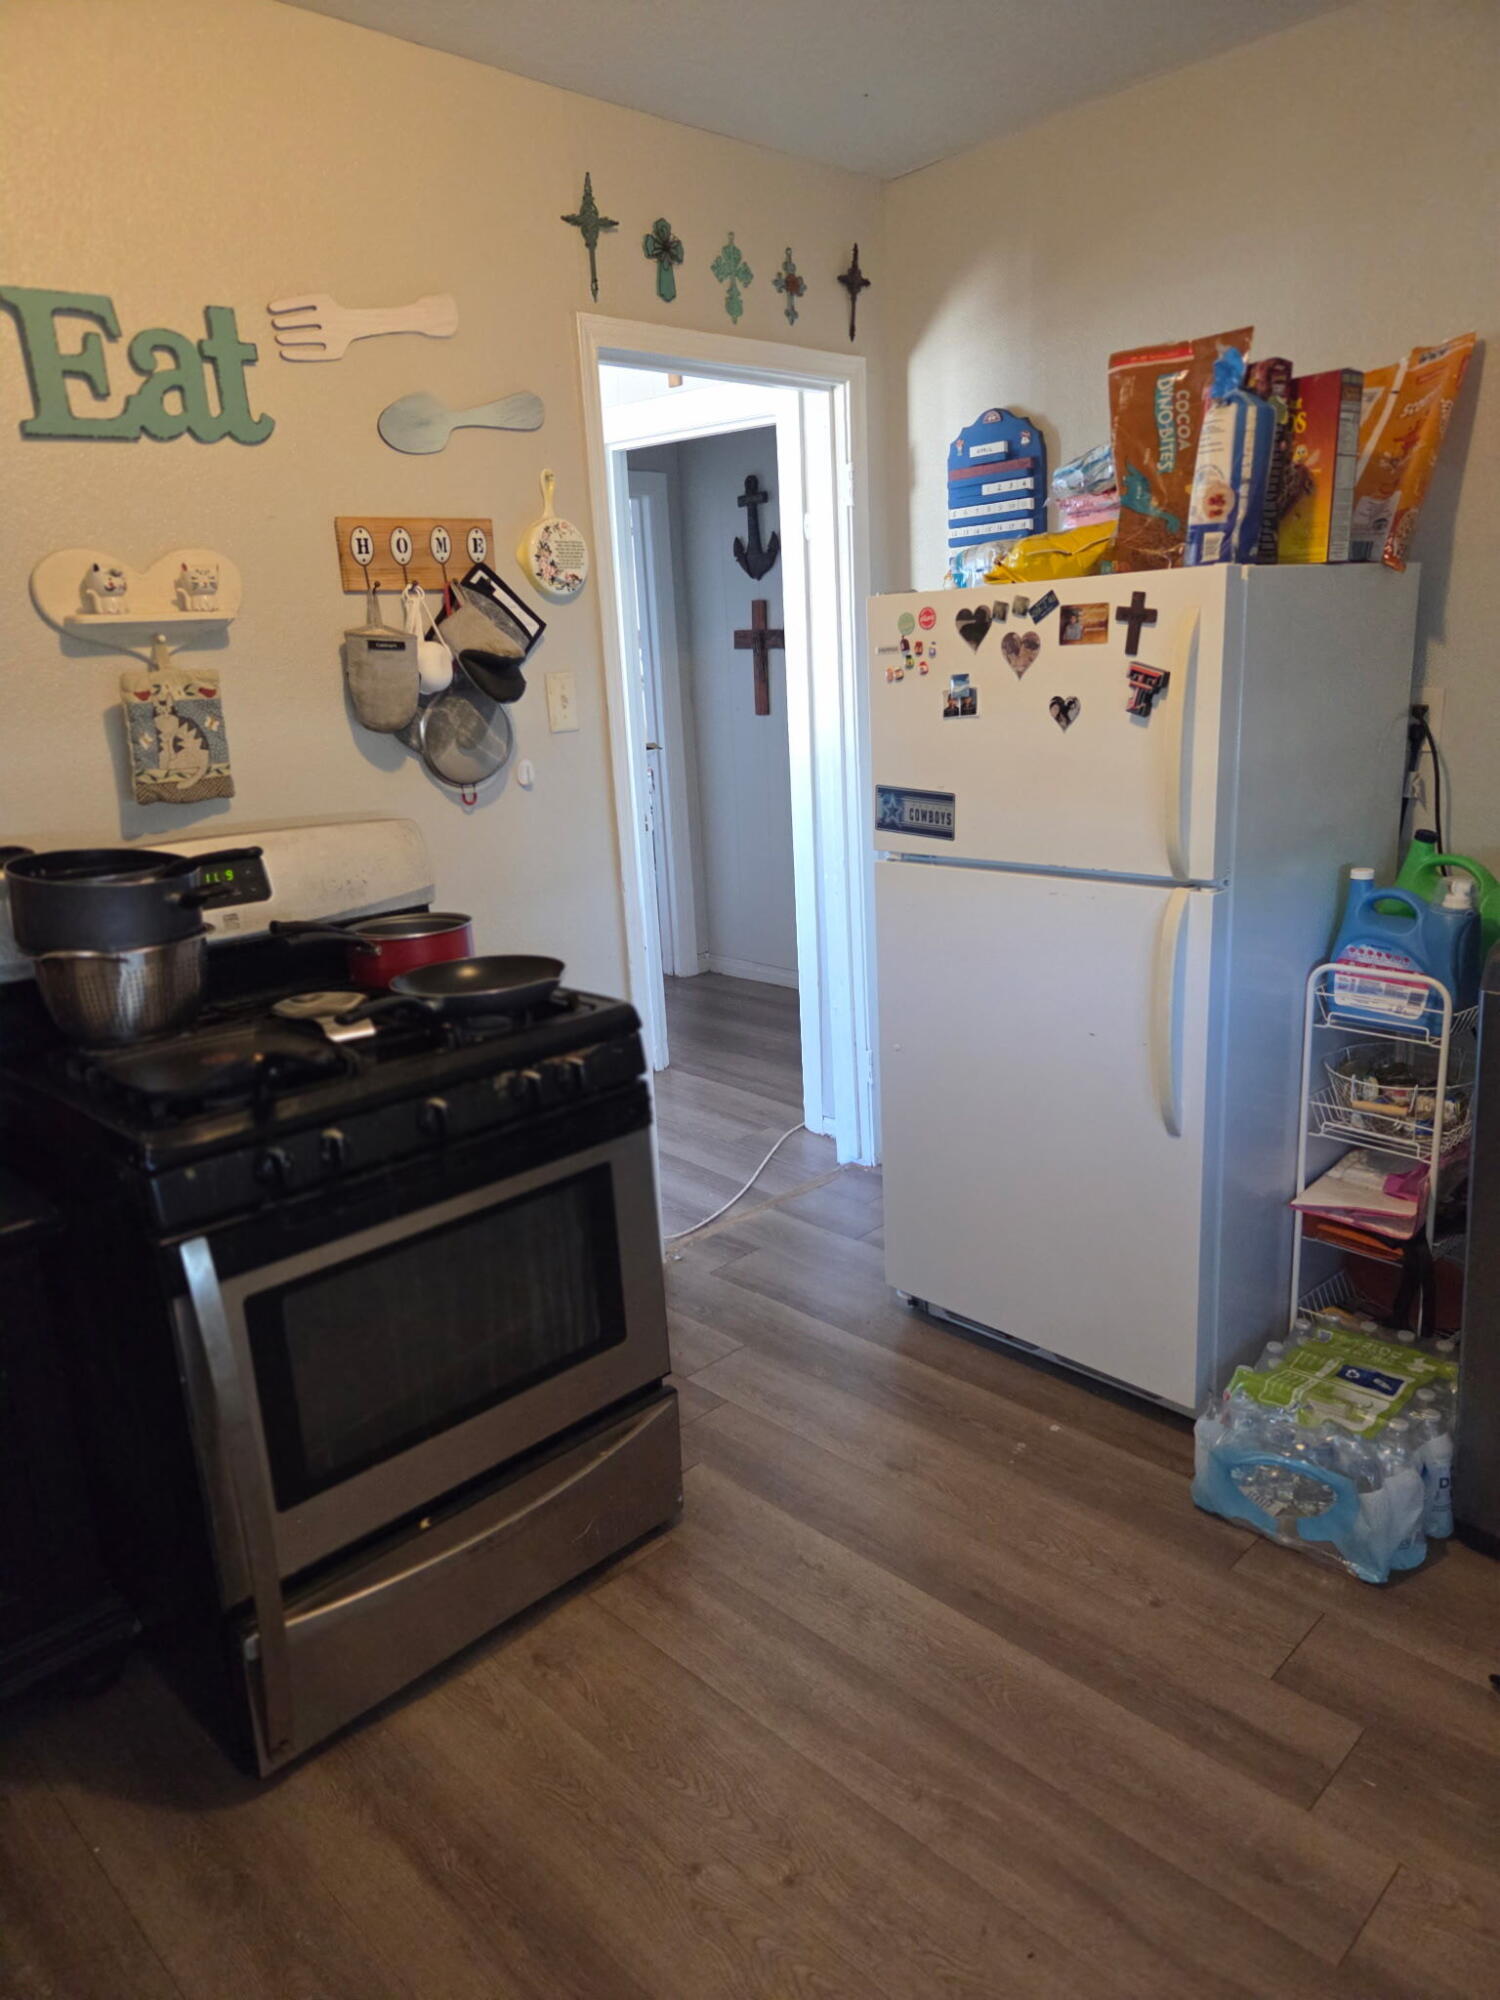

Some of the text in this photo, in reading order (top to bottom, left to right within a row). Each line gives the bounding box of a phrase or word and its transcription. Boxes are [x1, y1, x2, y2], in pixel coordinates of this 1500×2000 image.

[0, 285, 276, 446] Eat
[1175, 389, 1192, 451] COCOA
[355, 537, 485, 555] HOME
[909, 807, 952, 826] COWBOYS
